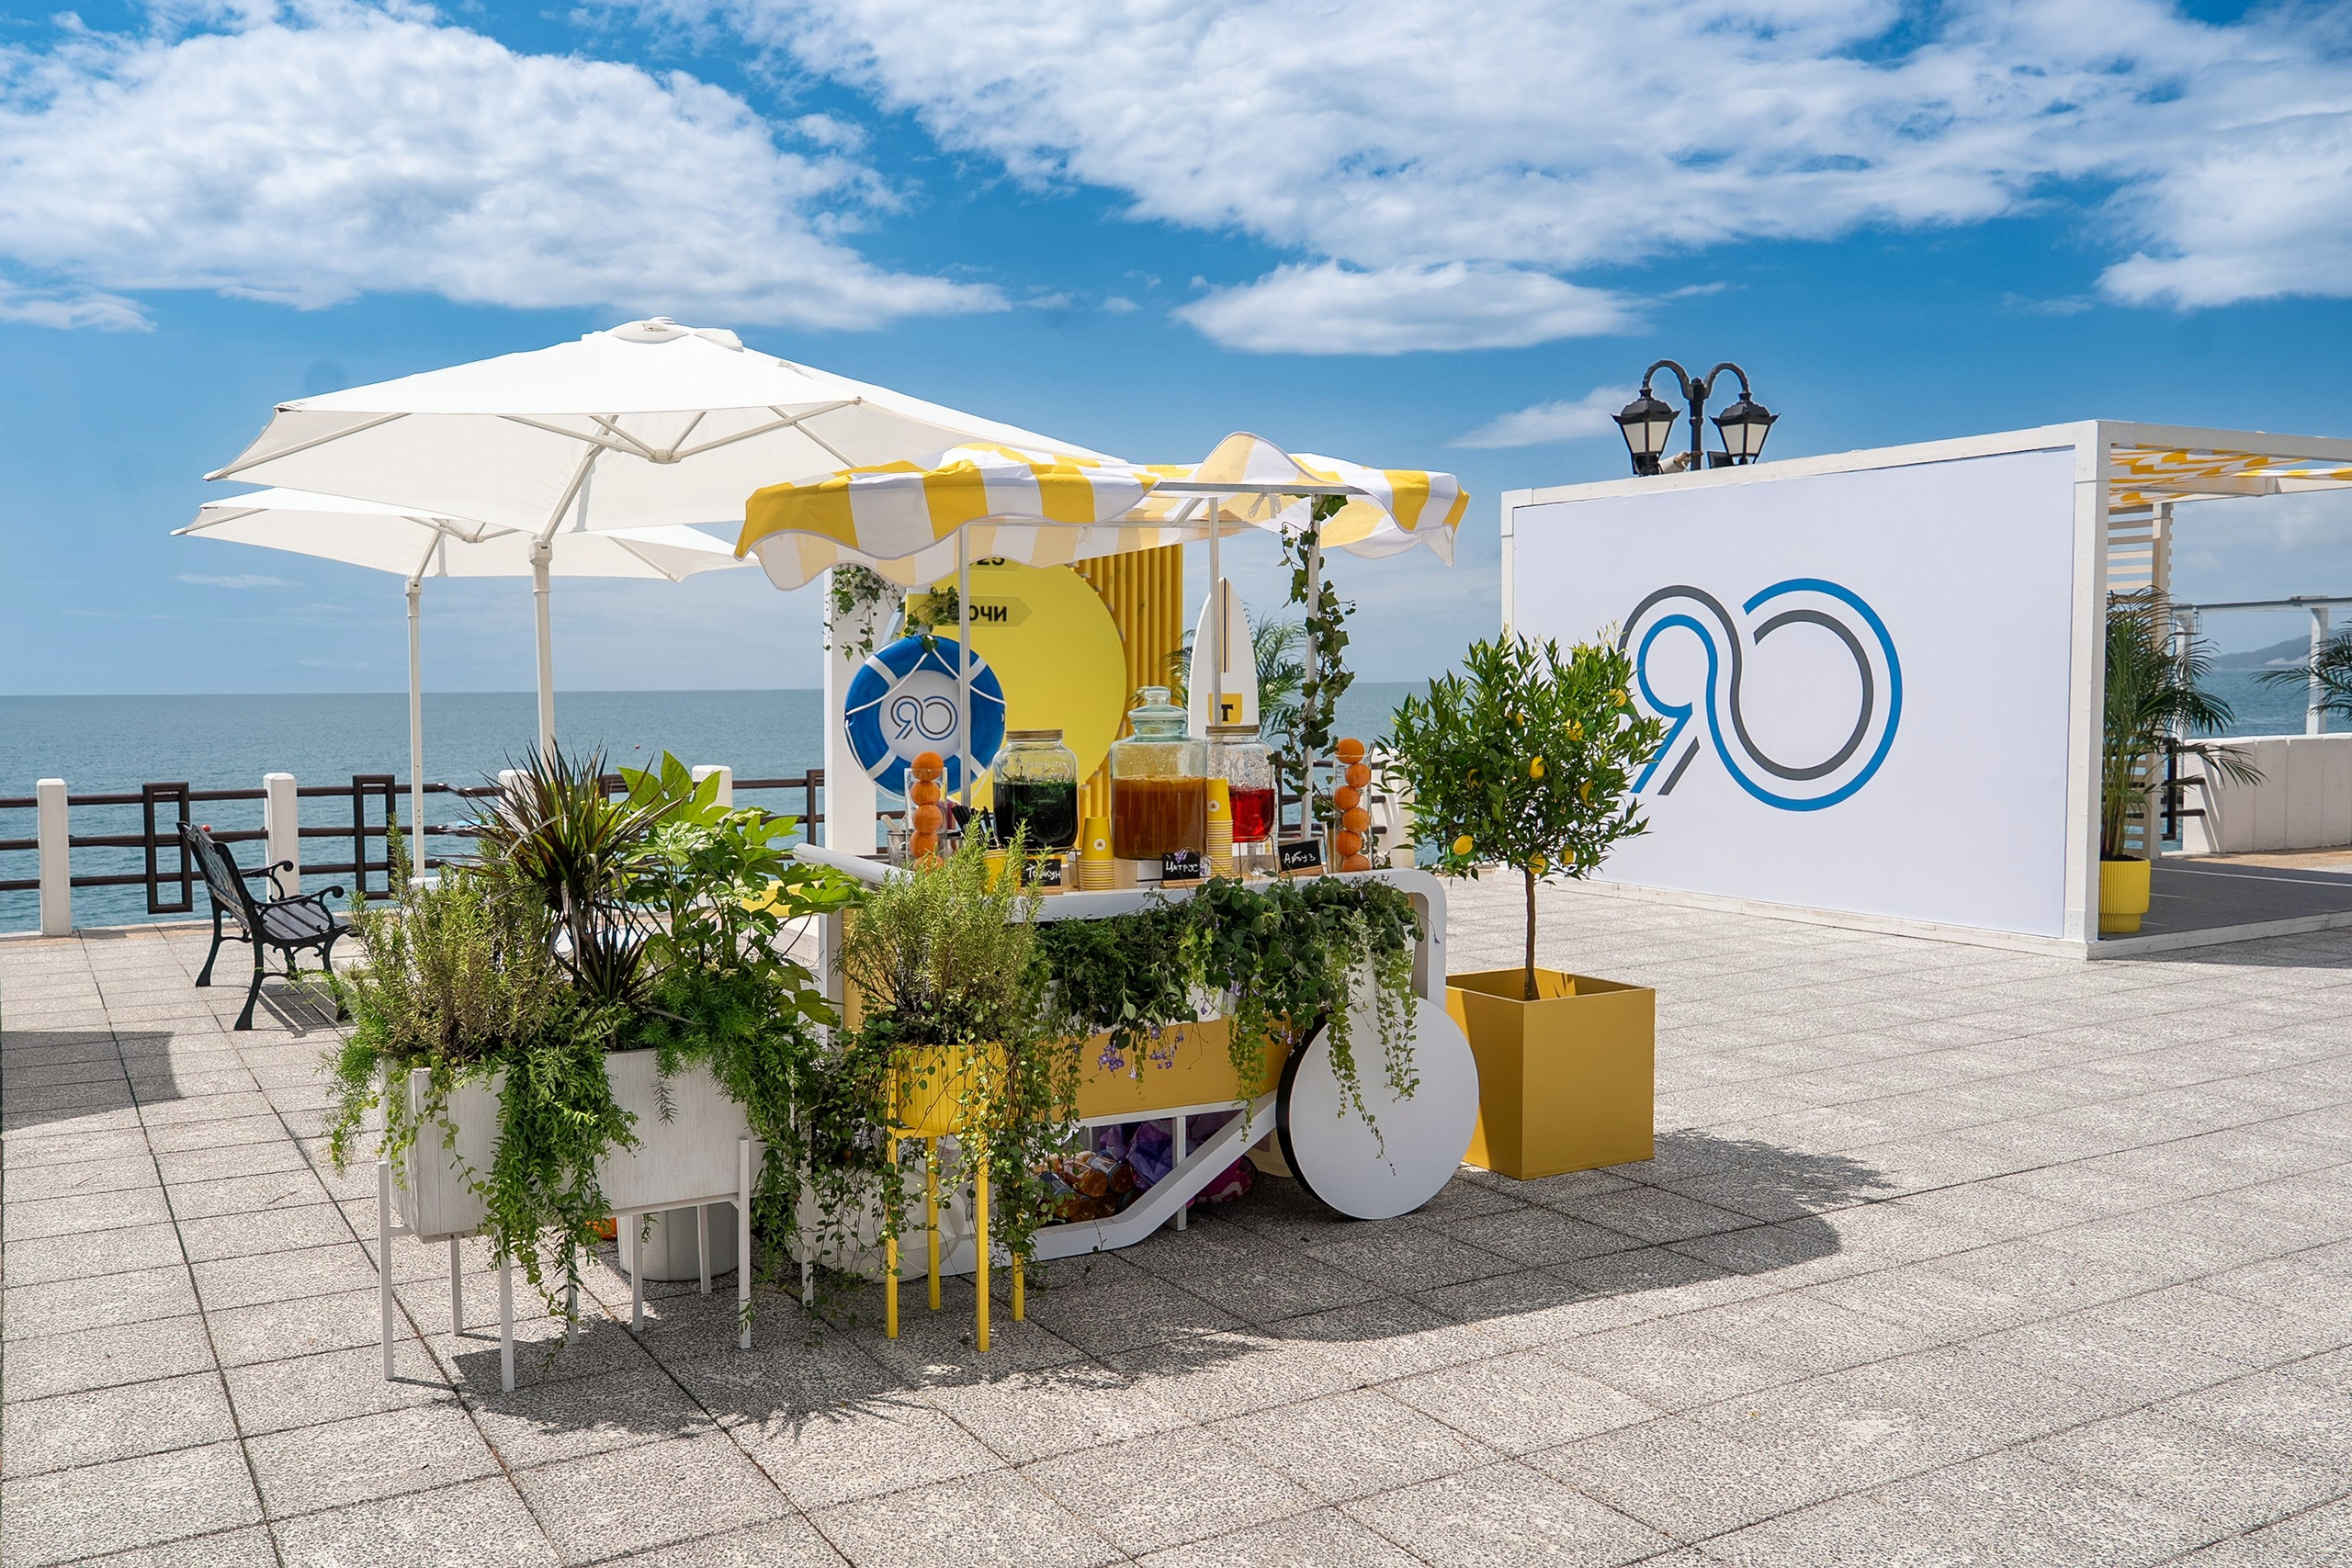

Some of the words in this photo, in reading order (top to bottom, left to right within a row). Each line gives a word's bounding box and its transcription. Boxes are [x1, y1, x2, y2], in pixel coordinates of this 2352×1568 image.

[954, 605, 1007, 622] ОЧИ
[1283, 851, 1316, 863] Арбуз
[1165, 861, 1199, 873] Цитрус
